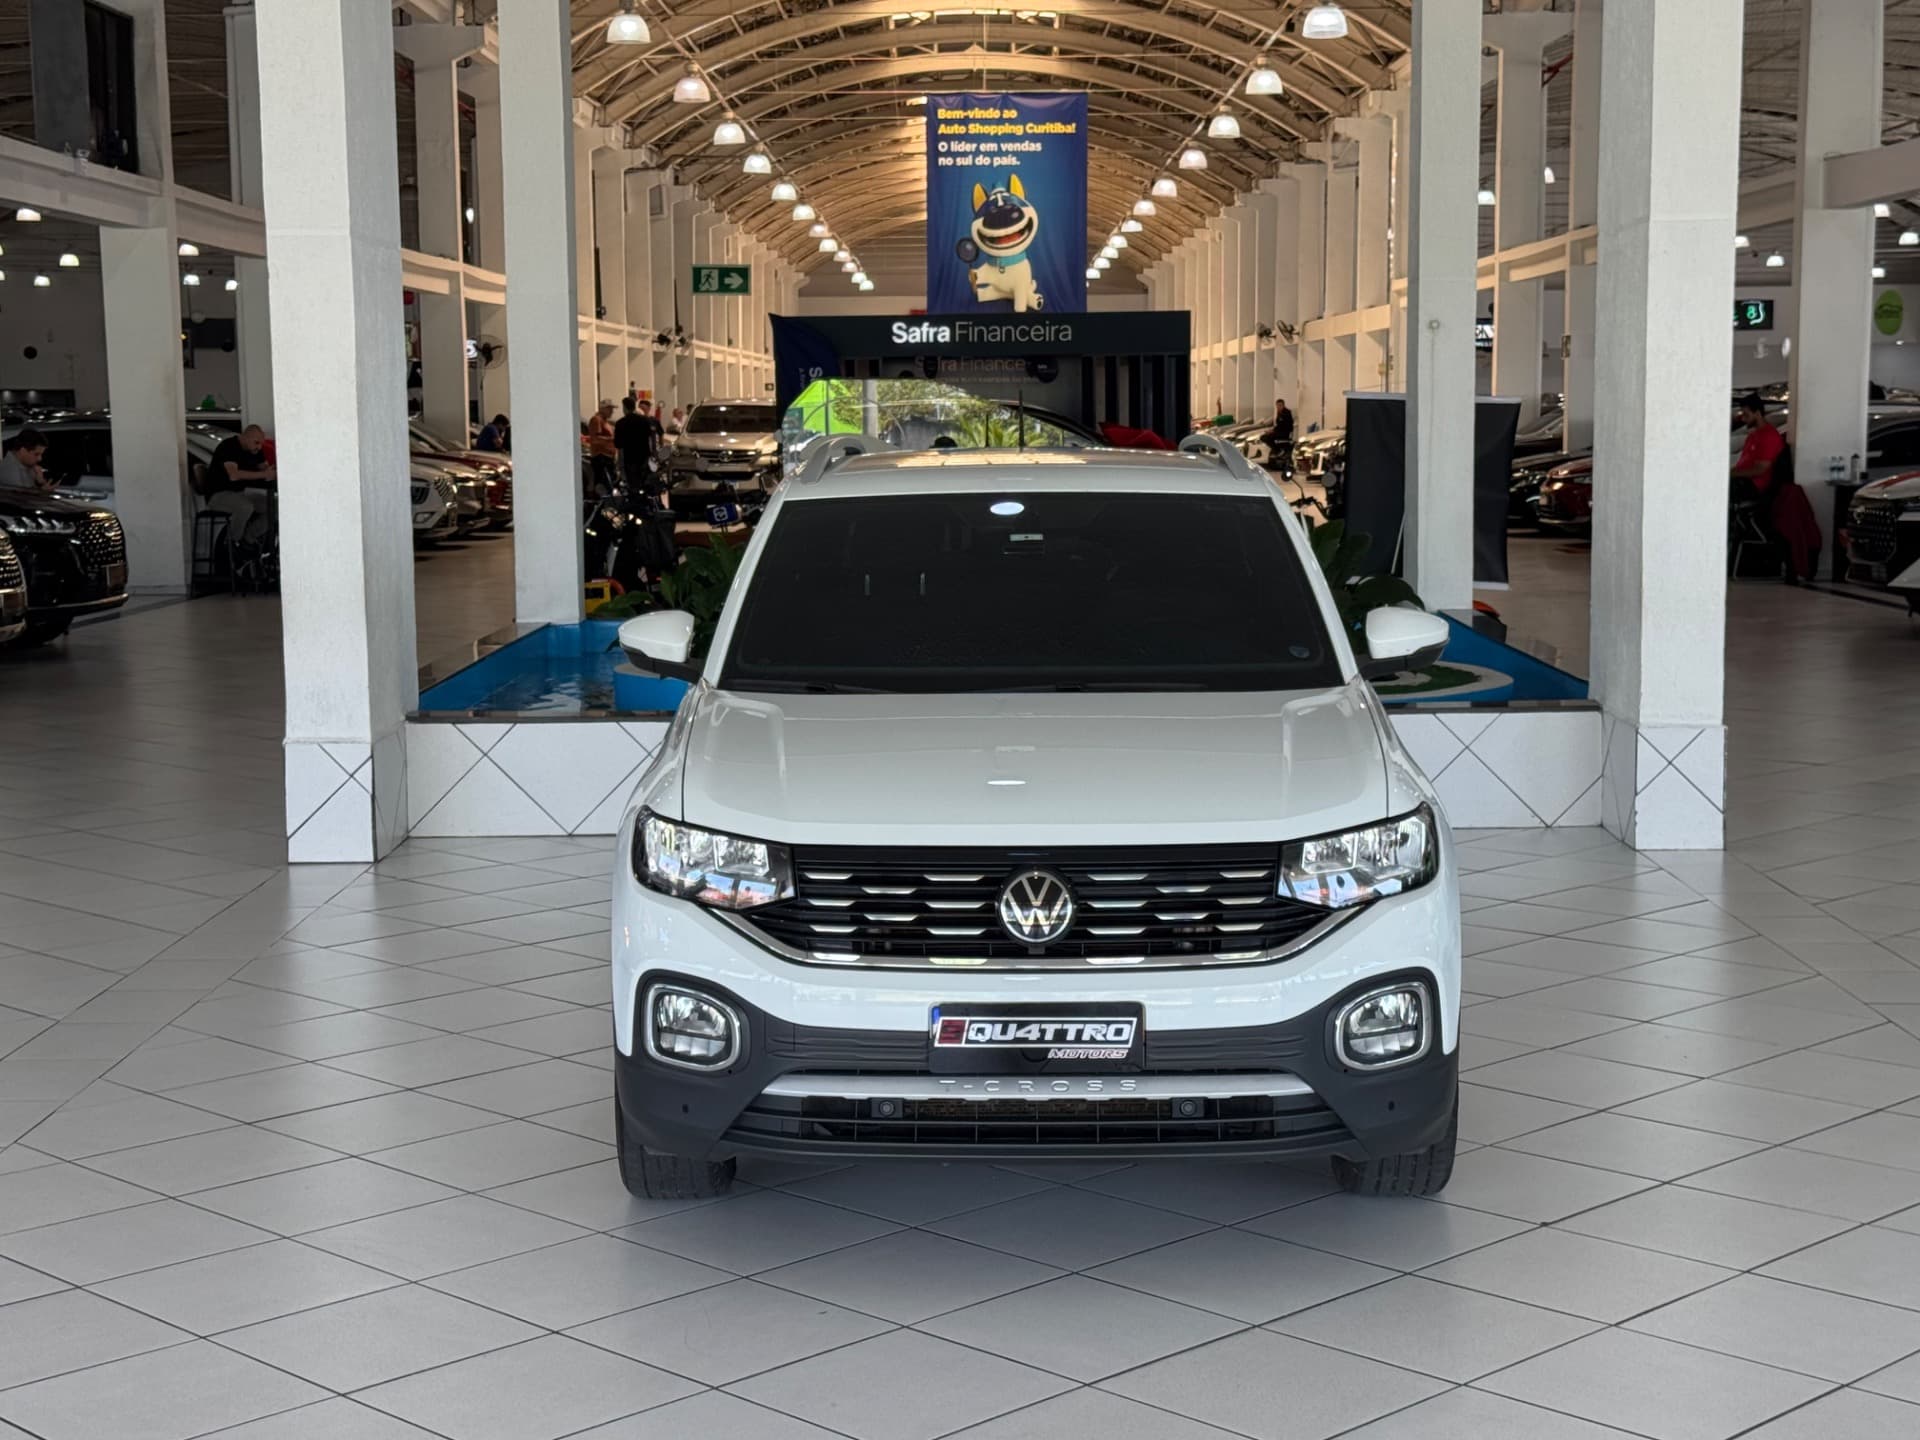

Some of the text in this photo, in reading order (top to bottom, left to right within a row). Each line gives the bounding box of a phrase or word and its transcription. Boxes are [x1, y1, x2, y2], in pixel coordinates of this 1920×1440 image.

[937, 108, 1018, 119] Bem-vindo ao
[938, 121, 1077, 136] Auto Shopping Curitiba!
[938, 140, 1042, 152] O líder em vendas
[938, 154, 1021, 167] no sul do país.
[892, 320, 1073, 344] Safra Financeira
[967, 1022, 1133, 1042] QU4TTRO
[1047, 1048, 1129, 1059] MOTORS
[938, 1079, 1138, 1093] T-CROSS
